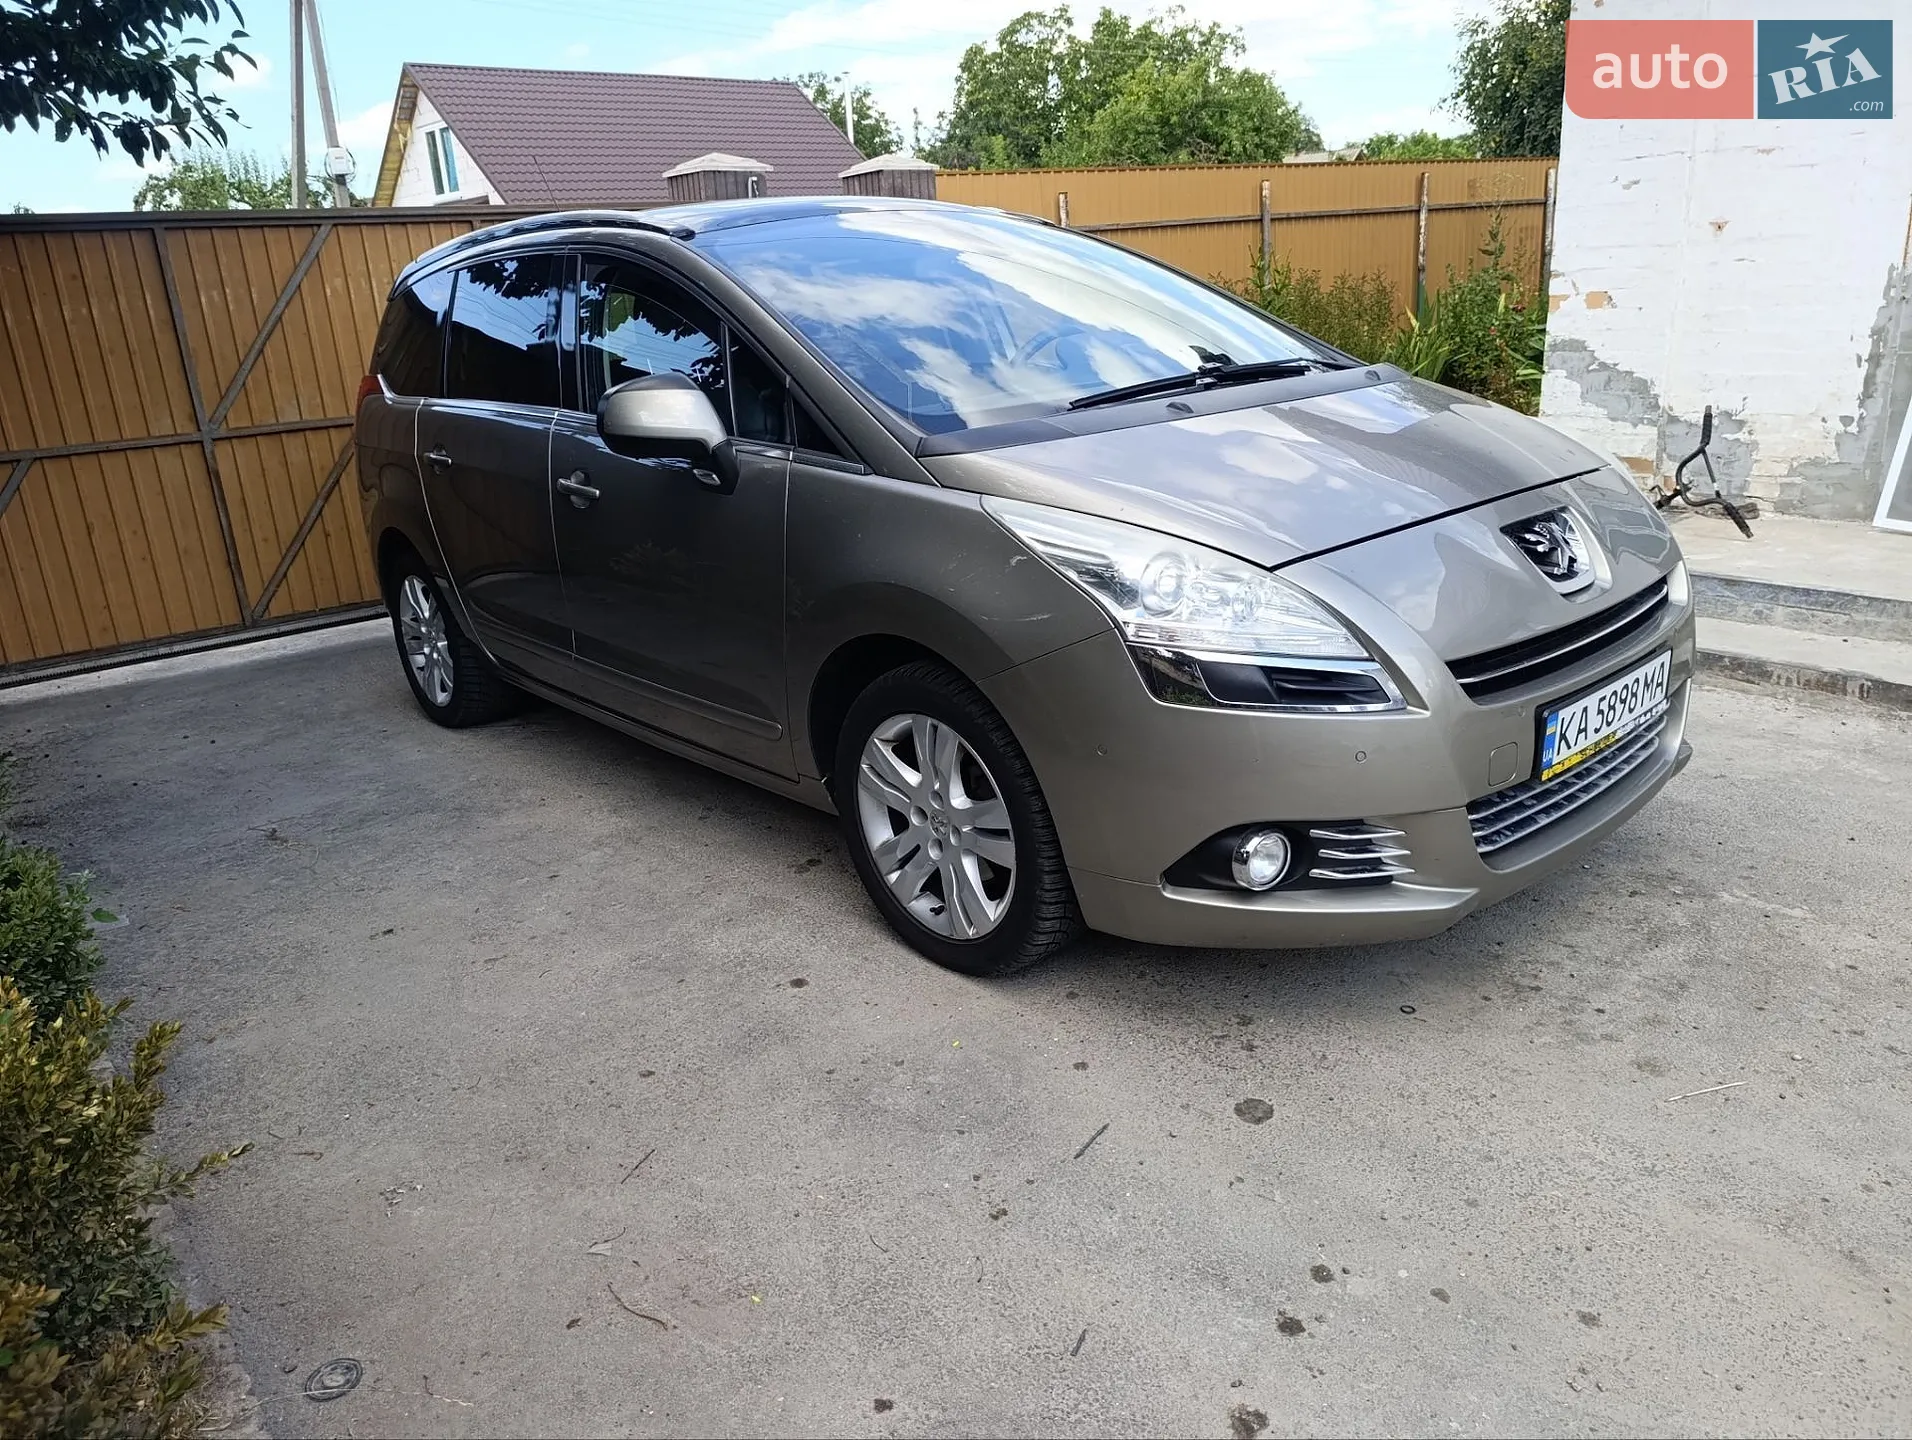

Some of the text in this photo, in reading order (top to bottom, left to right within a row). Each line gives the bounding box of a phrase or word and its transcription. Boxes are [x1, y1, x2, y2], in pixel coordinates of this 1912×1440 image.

[1556, 705, 1588, 756] KA
[1593, 677, 1640, 735] 5898
[1542, 748, 1553, 763] UA
